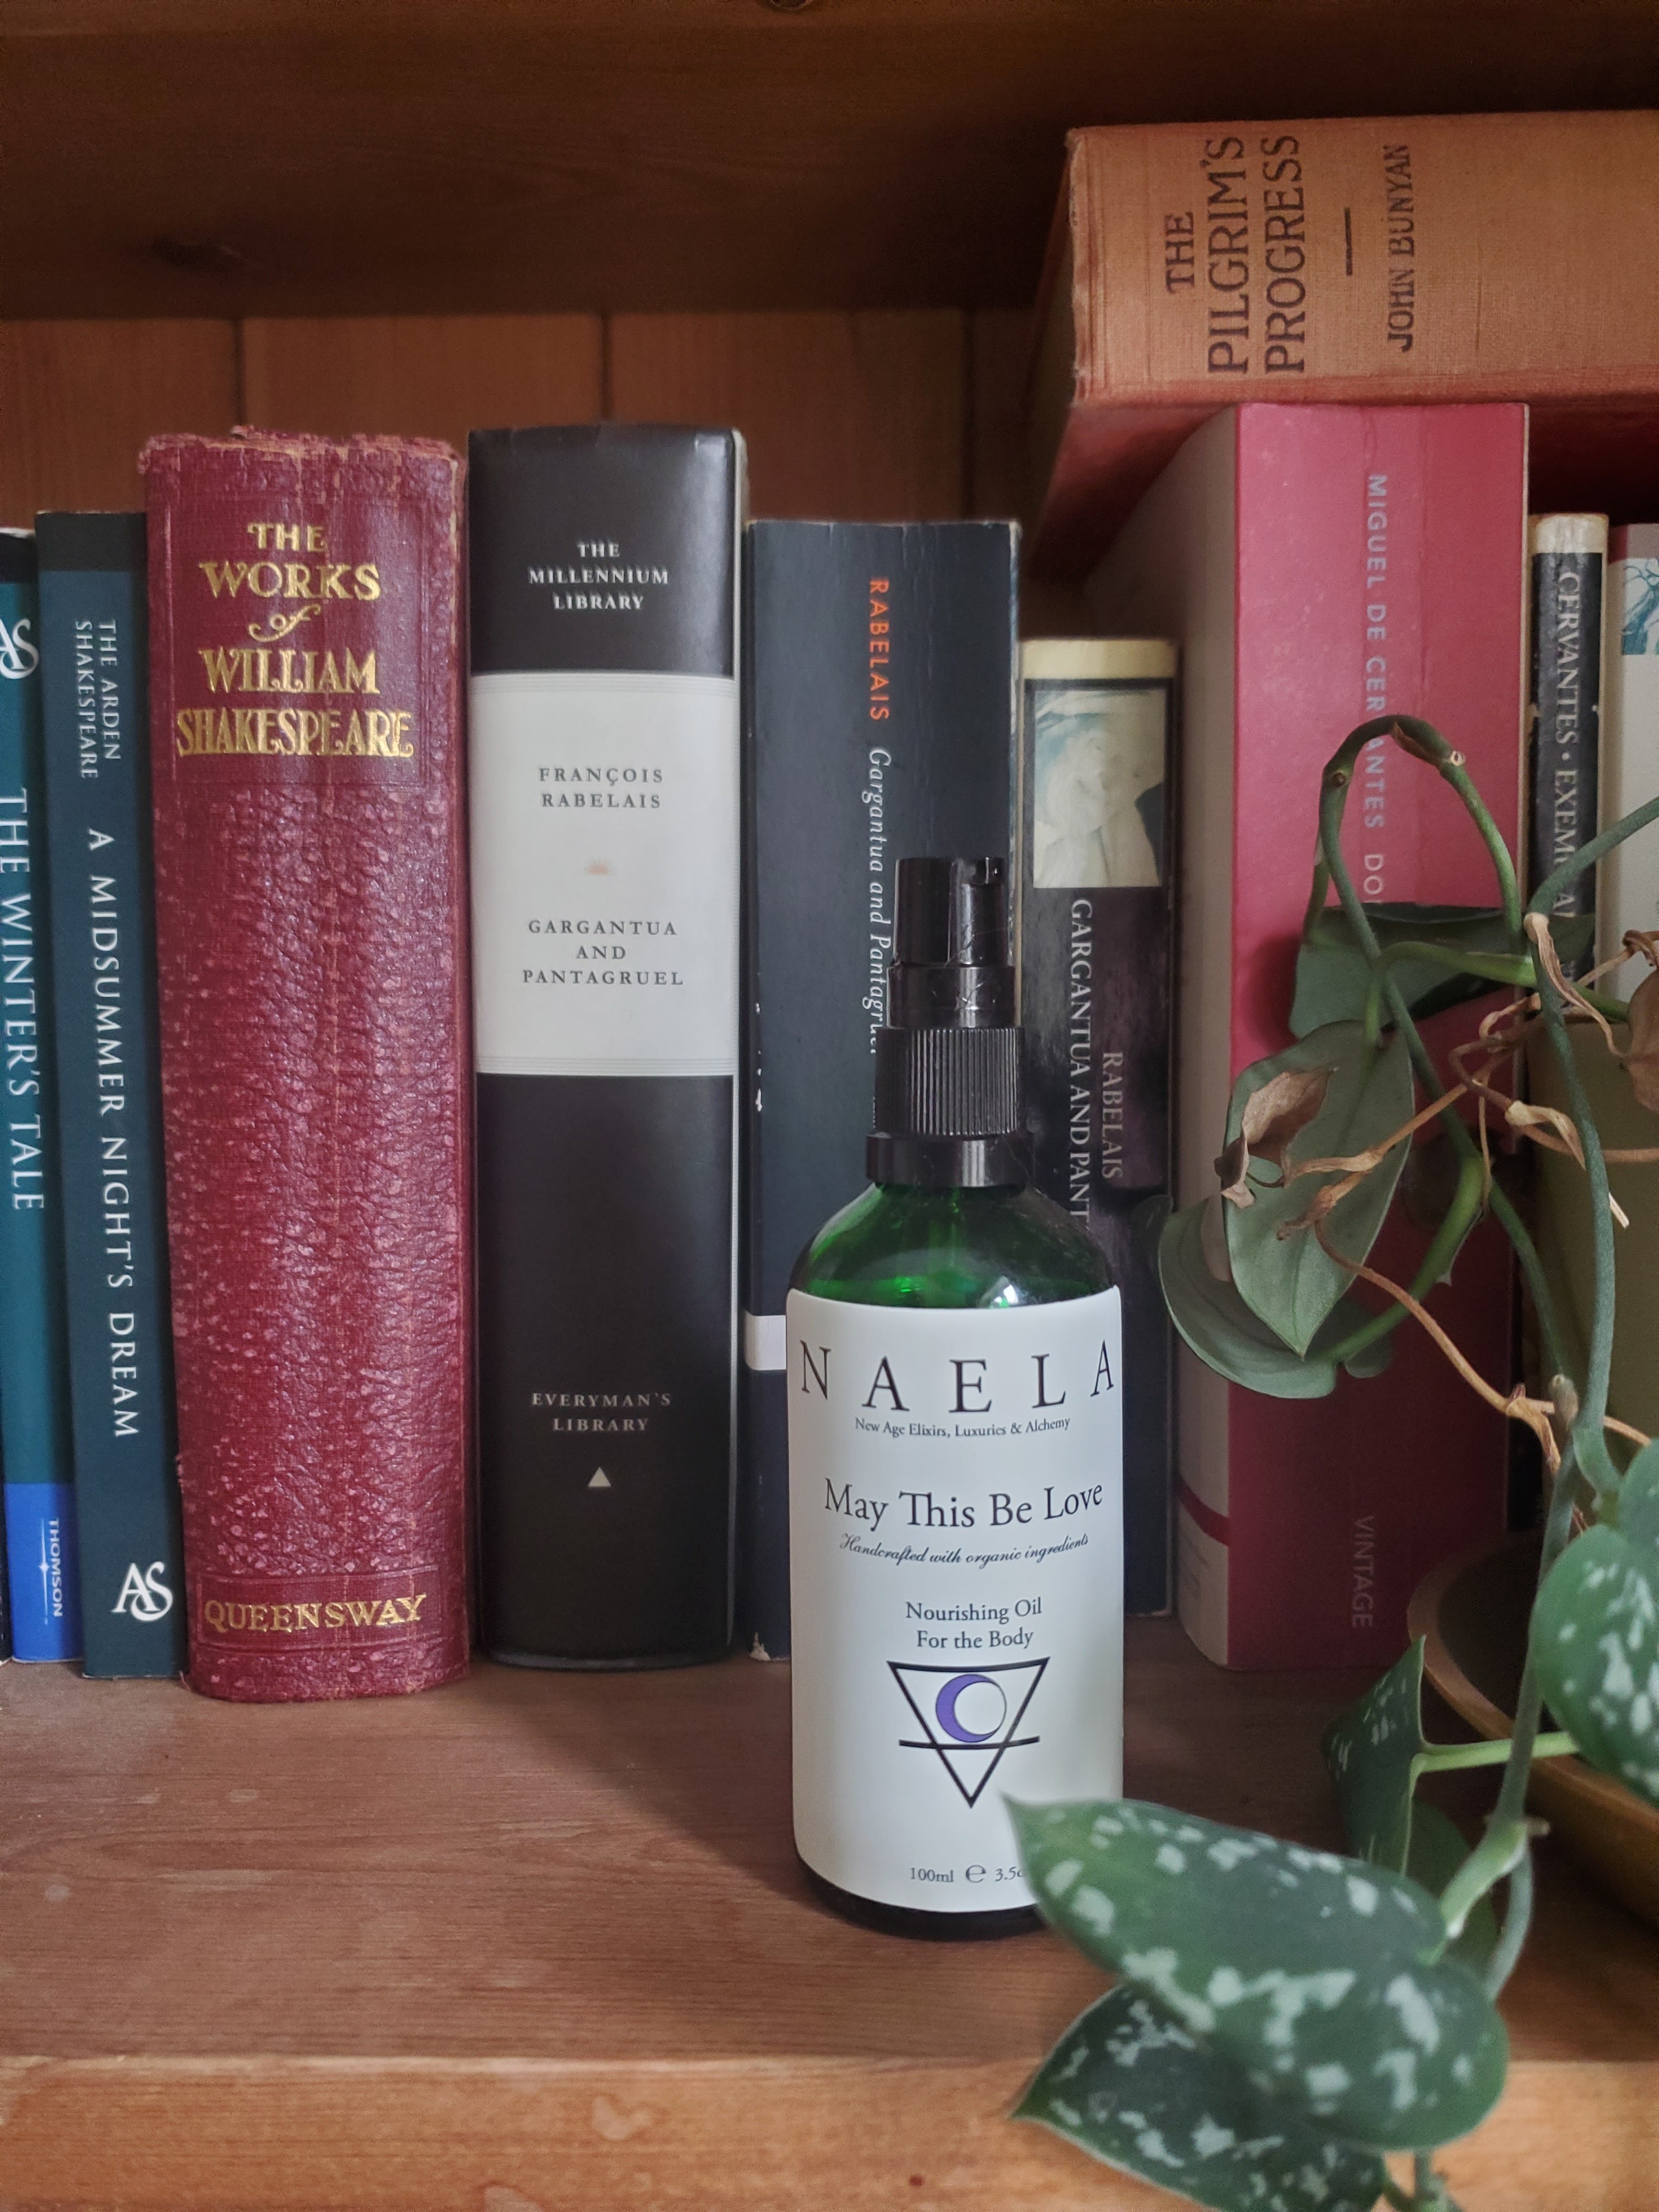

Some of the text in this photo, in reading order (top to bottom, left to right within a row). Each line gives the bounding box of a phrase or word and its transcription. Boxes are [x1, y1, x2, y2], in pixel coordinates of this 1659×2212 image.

[1165, 211, 1195, 294] THE
[1199, 136, 1250, 374] PILGRIM'S
[1261, 134, 1306, 374] PROGRESS
[1383, 143, 1414, 352] JOHN BUNYAN
[247, 523, 328, 552] THE
[578, 540, 620, 558] THE
[199, 561, 381, 600] WORKS
[529, 568, 669, 585] MILLENNIUM
[248, 605, 321, 642] of
[552, 594, 644, 611] LIBRARY
[199, 647, 379, 695] WILLIAM
[1556, 572, 1581, 744] CERVANTES
[76, 620, 98, 779] SHAKESPEARE
[100, 620, 121, 760] THE ARDEN
[1363, 475, 1387, 903] MIGUEL DE CERANTES DO
[176, 707, 414, 758] SHAKESPEARE
[539, 768, 663, 787] FRANÇOIS
[541, 793, 661, 809] RABELAIS
[862, 579, 892, 1054] RABELAIS Gargantua and Pantagru
[528, 919, 678, 936] GARGANTUA
[576, 945, 627, 961] AND
[0, 787, 44, 1211] THE WINTER'S TALE
[523, 969, 684, 986] PANTAGRUEL
[1069, 899, 1092, 1226] GARGANTUA AND PANT
[88, 828, 139, 1438] A MIDSUMMER NIGHT'S DREAM
[1101, 1052, 1124, 1179] RABELAIS
[532, 1392, 672, 1406] EVERYMAN'S
[800, 1339, 1114, 1412] NAELA
[553, 1418, 649, 1431] LIBRARY
[855, 1417, 1071, 1437] New Age Elixirs, Luxuries & Alchemy
[825, 1477, 1103, 1531] May This Be Love
[49, 1516, 63, 1617] THOMSON
[839, 1533, 1089, 1569] Handcrafted with organic ingredients
[1352, 1515, 1374, 1628] VINTAGE
[111, 1561, 173, 1621] AS
[204, 1593, 426, 1634] QUEENSWAY
[905, 1596, 1042, 1624] Nourishing Oil
[917, 1626, 1034, 1649] For the Body
[910, 1867, 954, 1883] 100ml
